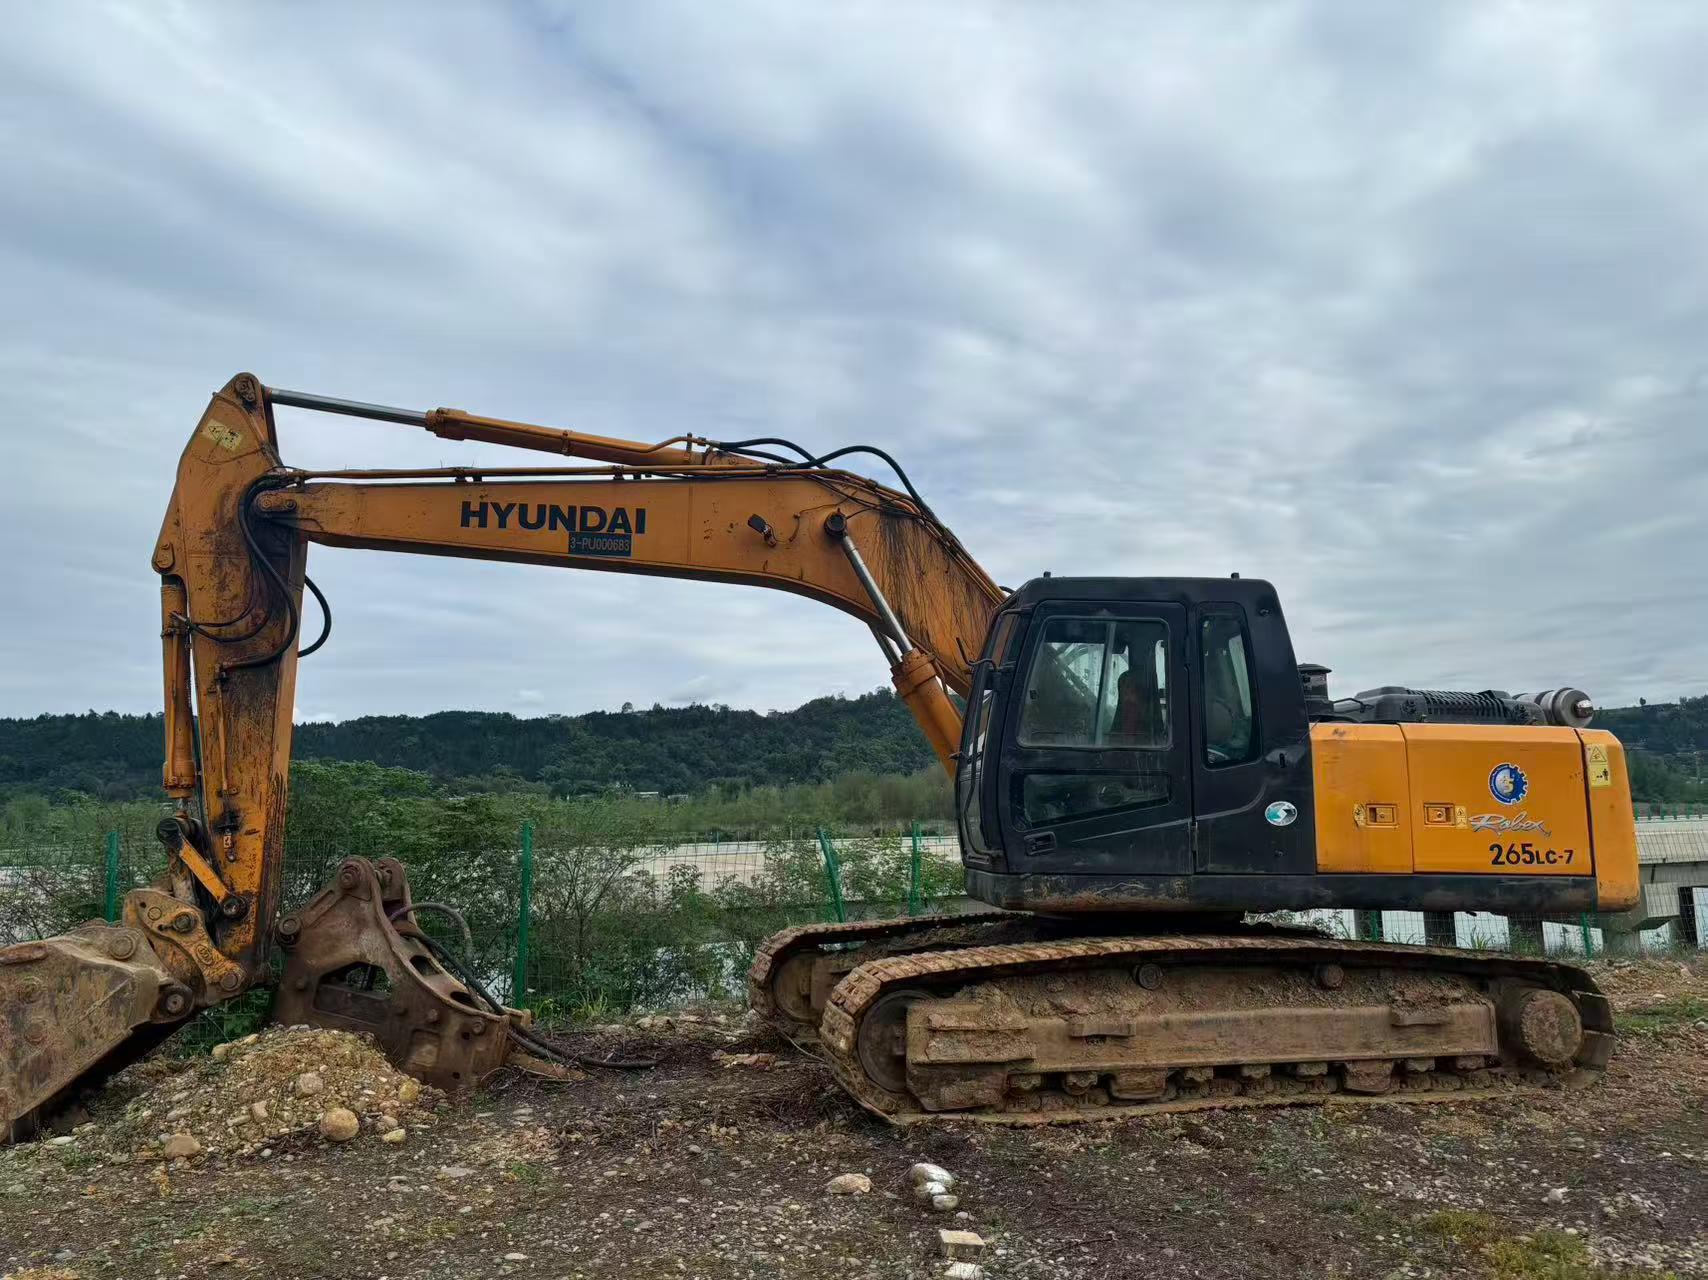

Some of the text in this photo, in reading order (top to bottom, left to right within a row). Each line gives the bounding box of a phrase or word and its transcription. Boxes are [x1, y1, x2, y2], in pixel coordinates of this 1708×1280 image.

[460, 501, 646, 534] HYUNDAI
[570, 536, 630, 552] 3-PU000683
[1469, 811, 1552, 837] Robex
[1489, 843, 1574, 866] 265LC-7
